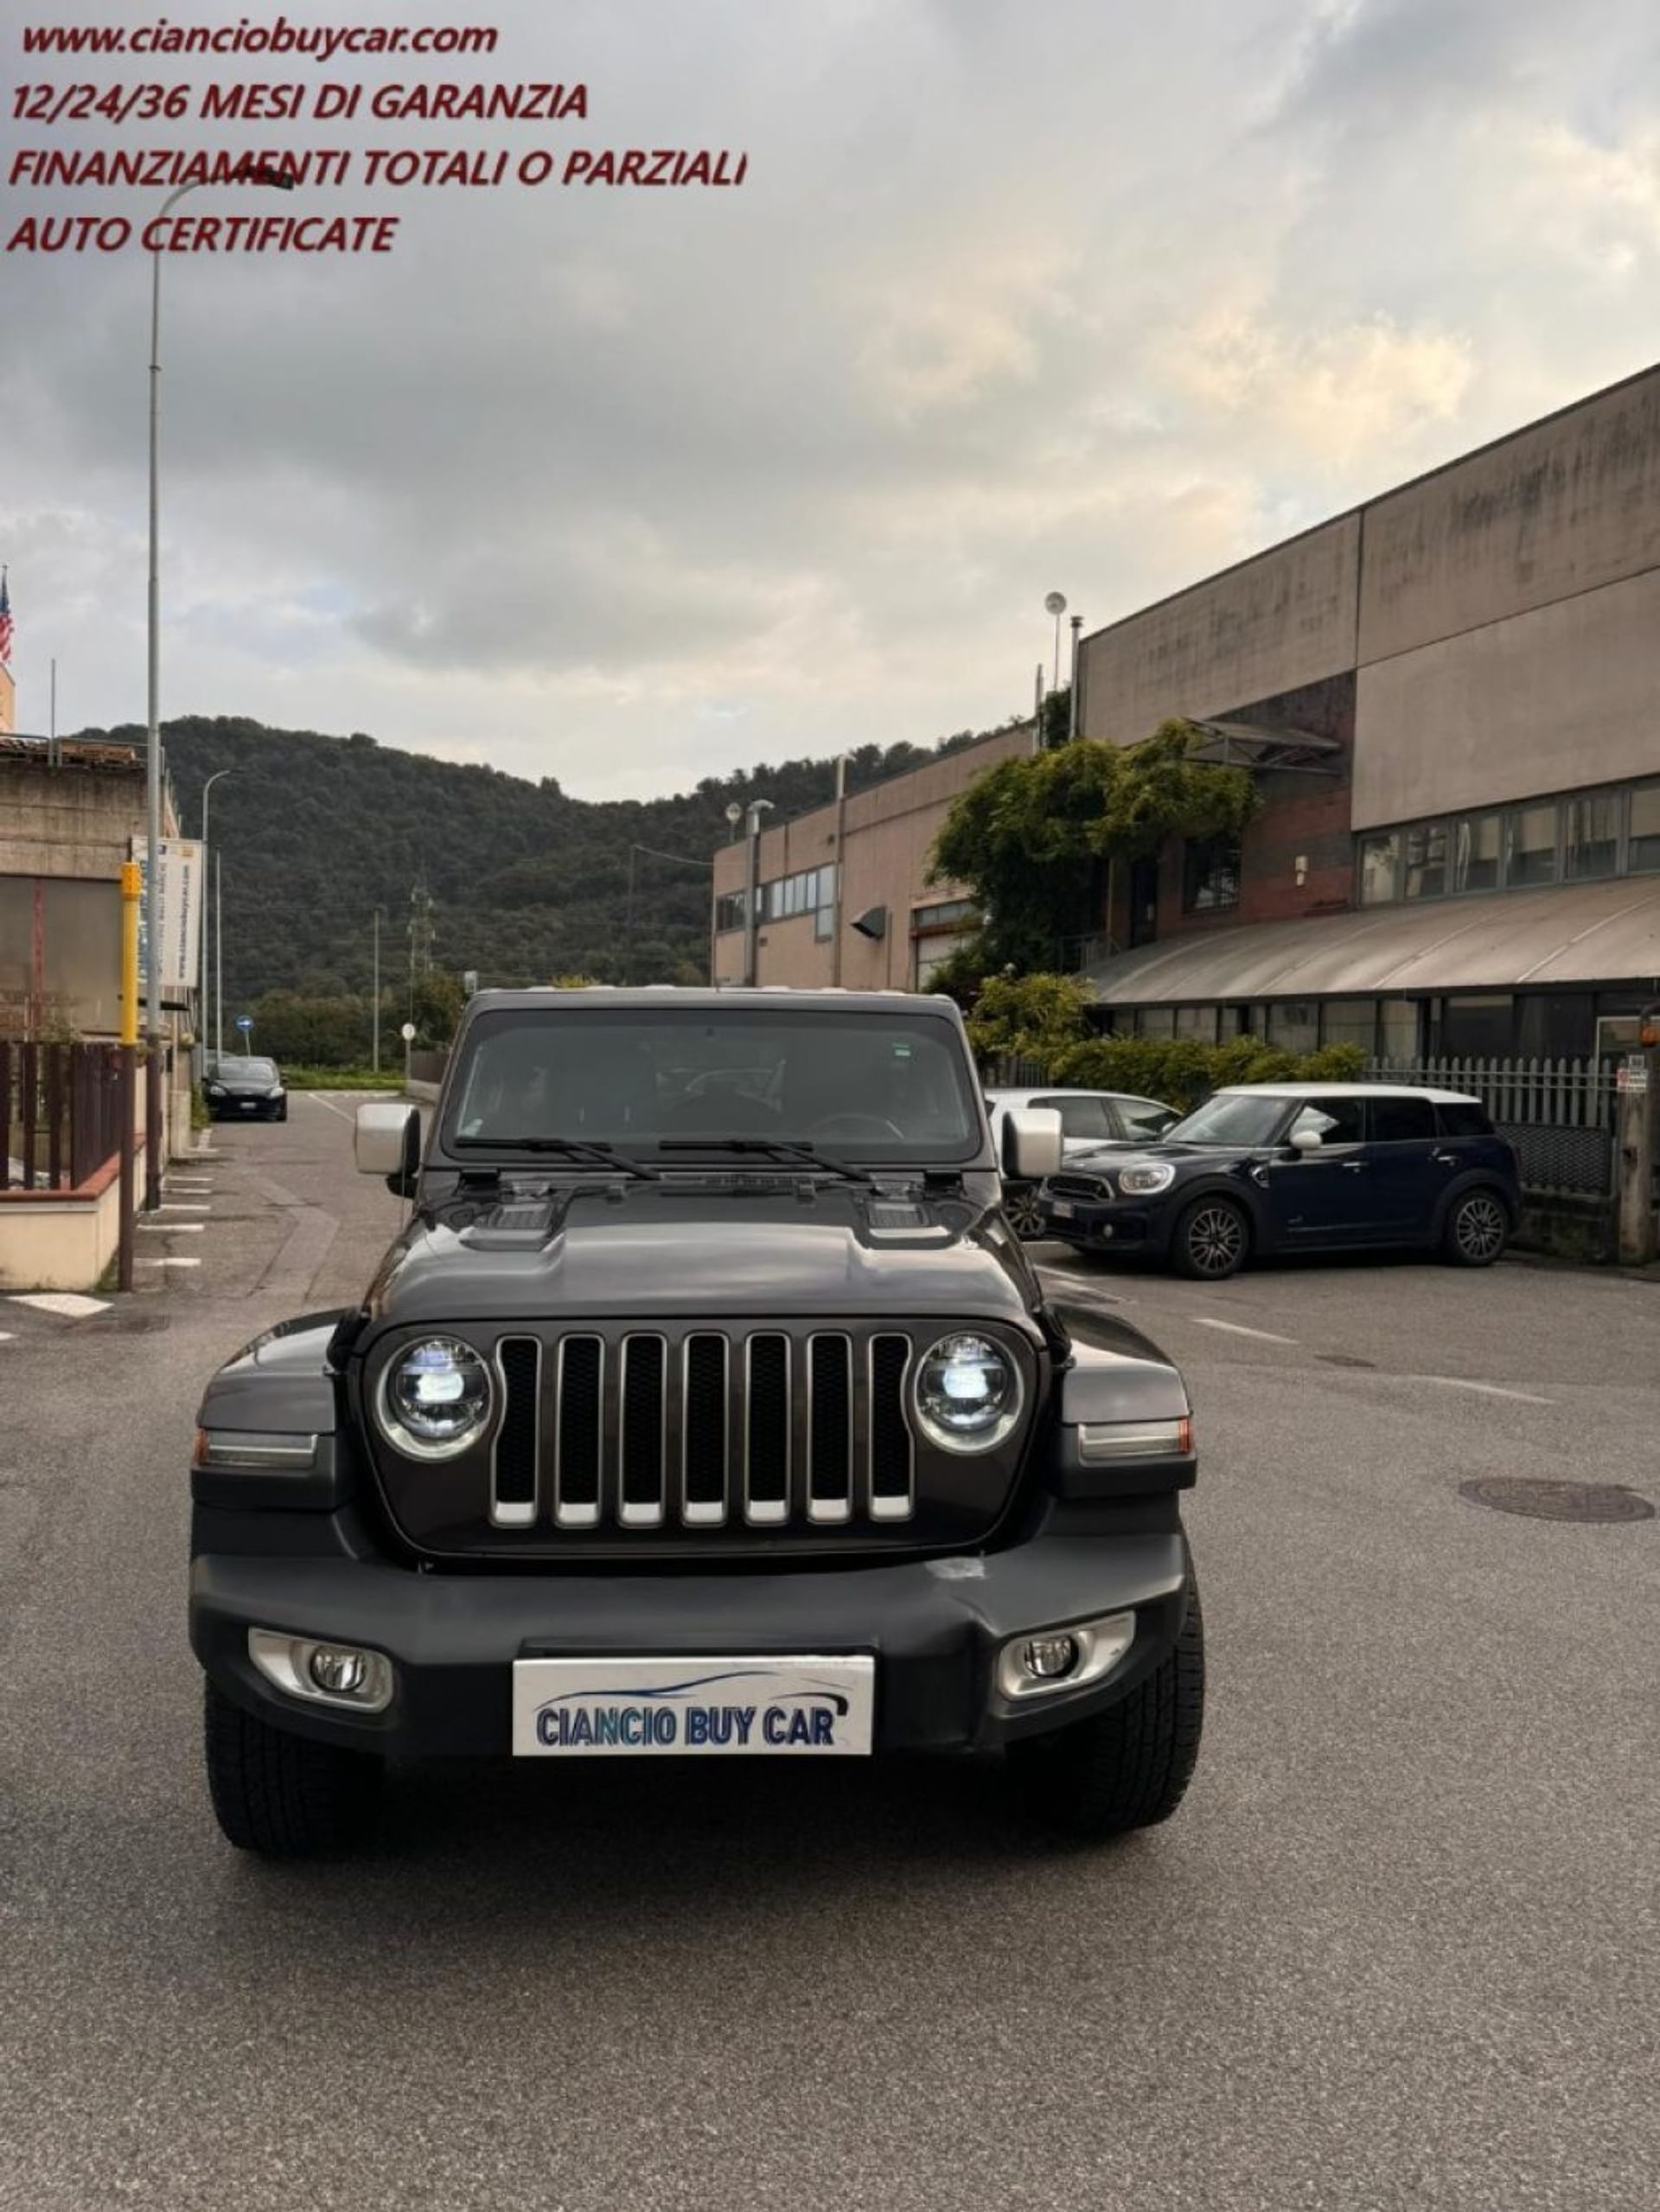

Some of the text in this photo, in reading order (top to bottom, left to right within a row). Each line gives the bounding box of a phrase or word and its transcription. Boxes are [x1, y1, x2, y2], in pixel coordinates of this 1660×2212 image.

[536, 1705, 835, 1746] CIANCIO BUY CAR
